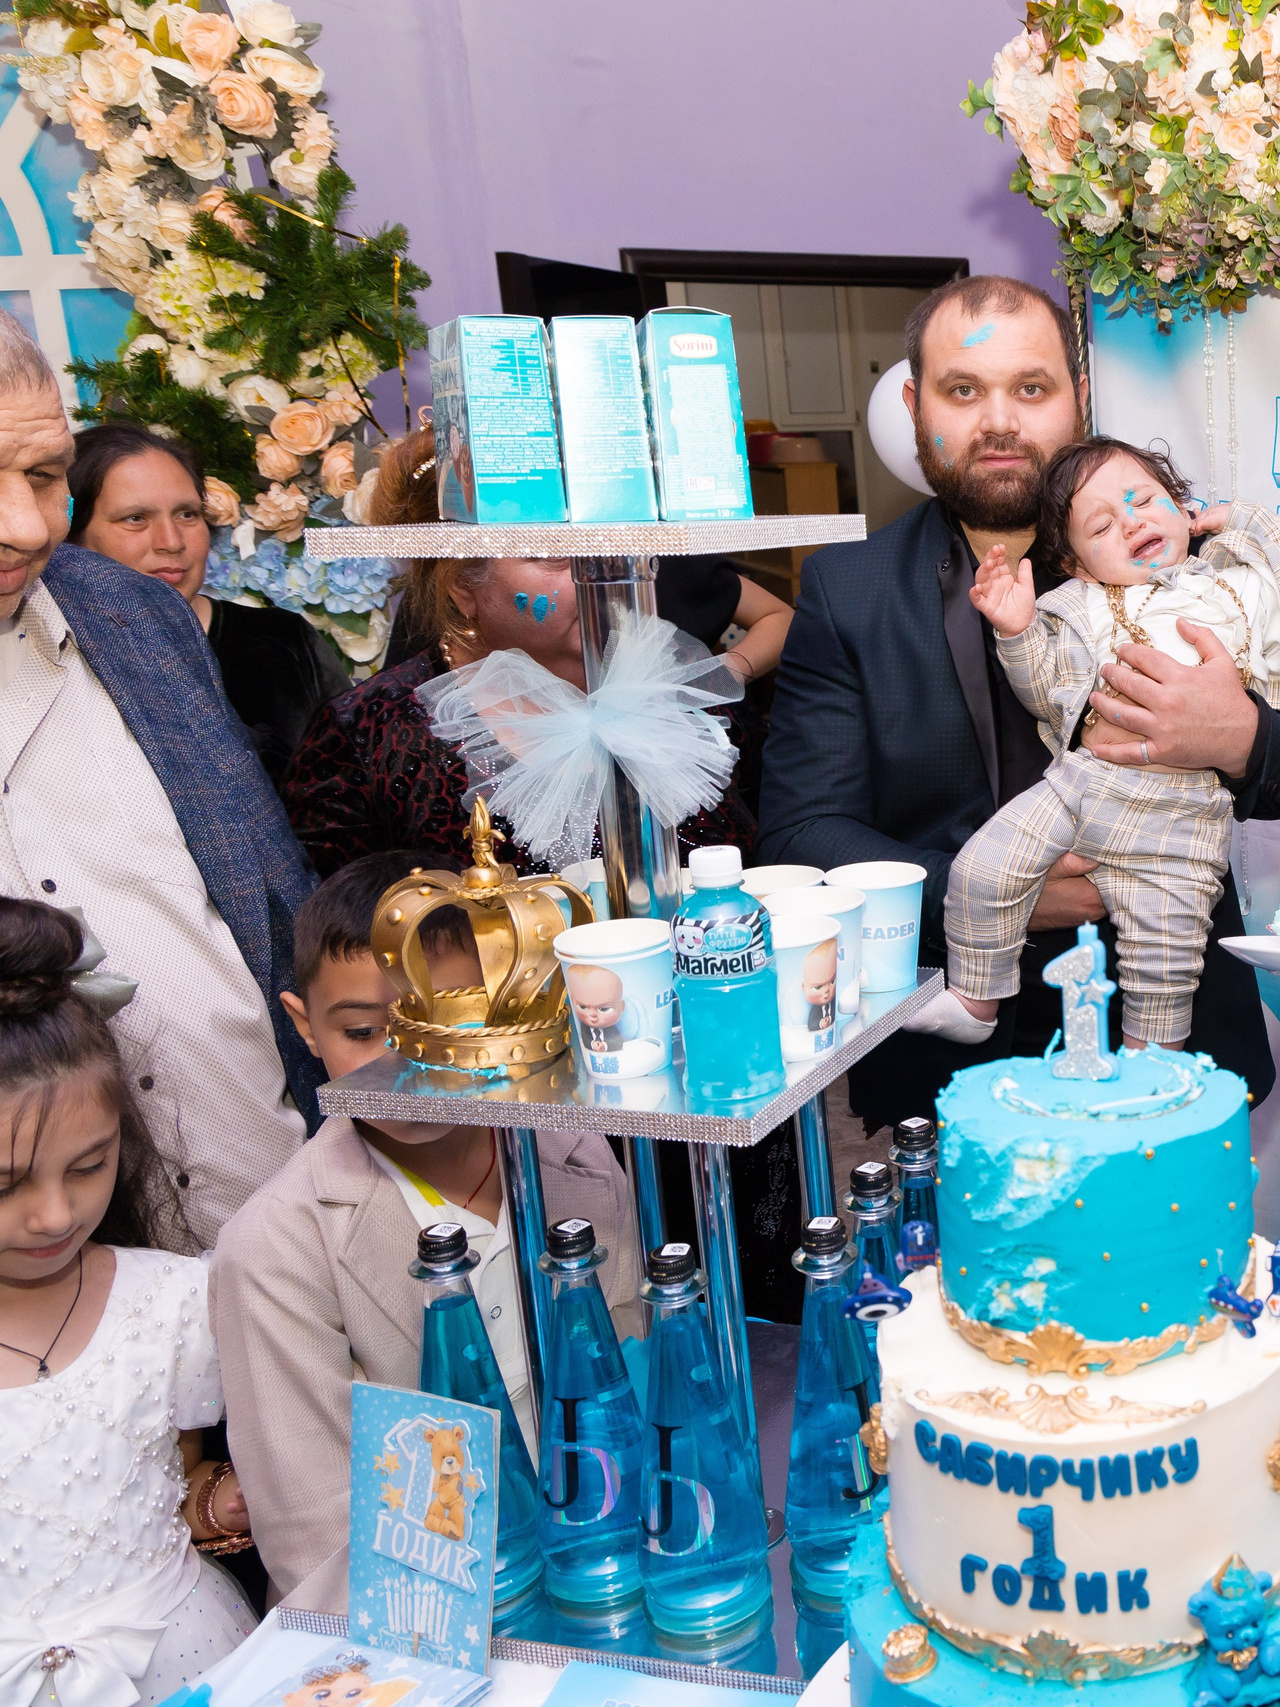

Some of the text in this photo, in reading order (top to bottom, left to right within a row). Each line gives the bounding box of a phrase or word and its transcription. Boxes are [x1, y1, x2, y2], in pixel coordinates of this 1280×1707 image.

[673, 339, 714, 352] Sorini
[707, 930, 737, 940] ТУТТИ
[860, 920, 917, 940] EADER
[676, 951, 754, 976] Marmell
[914, 1418, 1200, 1502] САБИРЧИКУ
[373, 1512, 478, 1591] ГОДИК
[1017, 1504, 1067, 1581] 1
